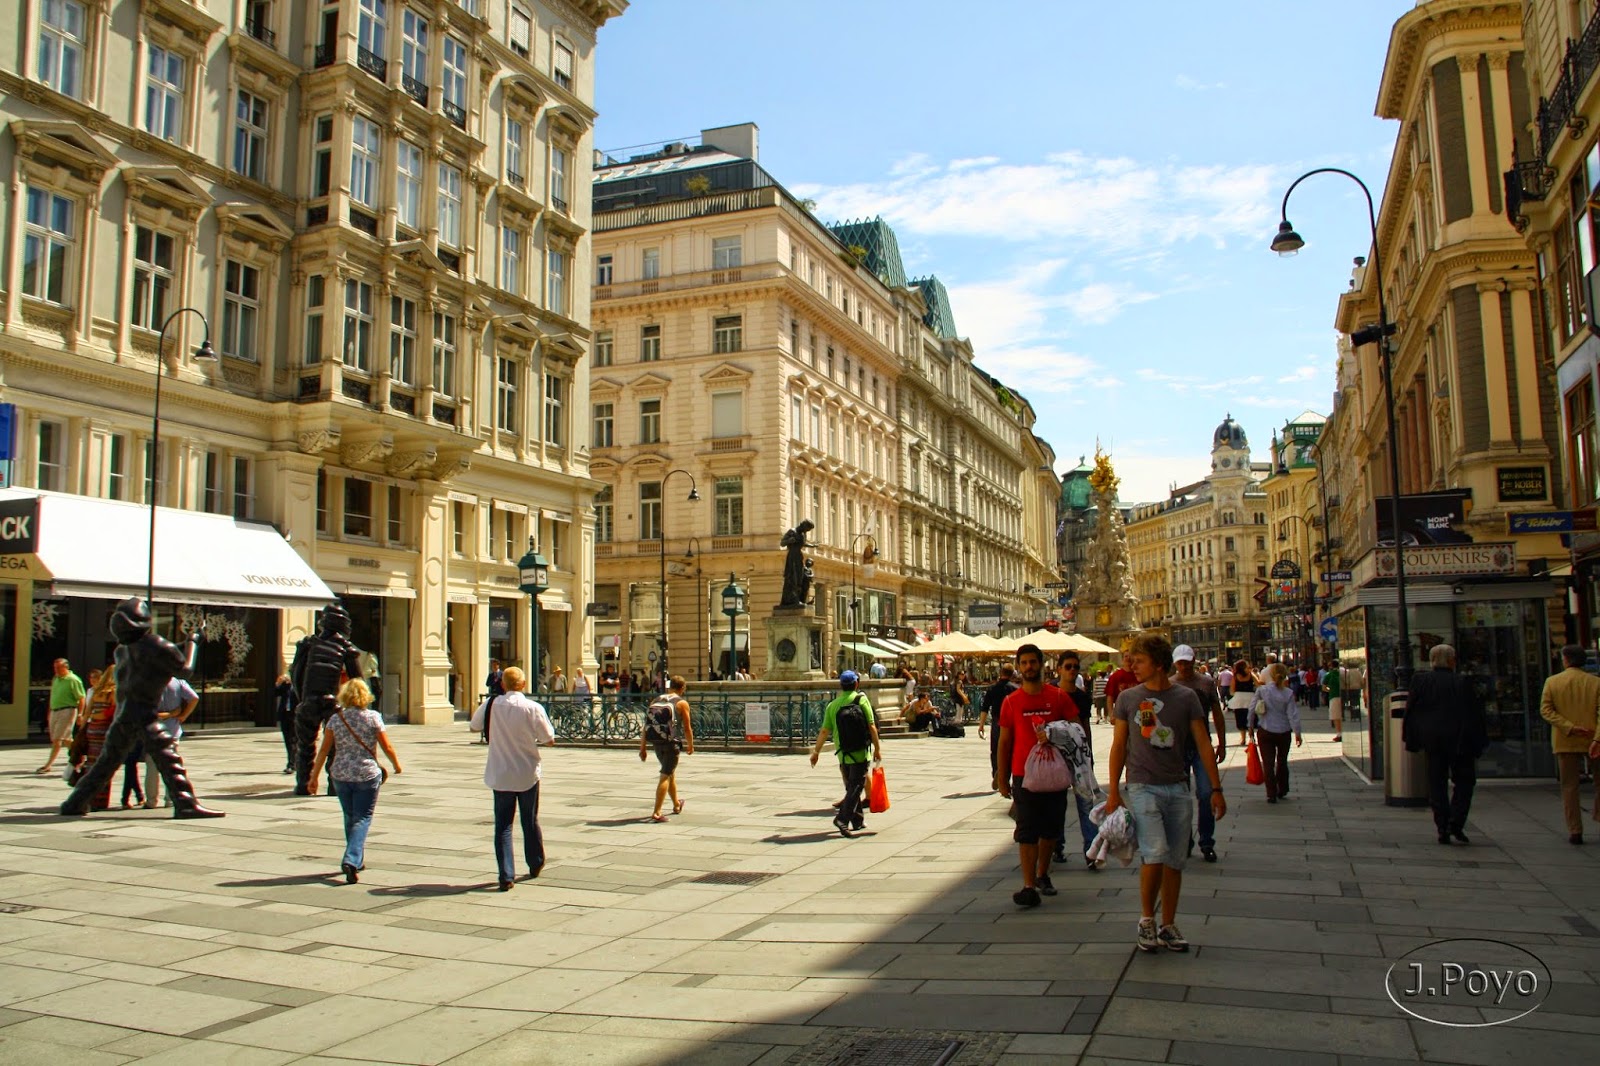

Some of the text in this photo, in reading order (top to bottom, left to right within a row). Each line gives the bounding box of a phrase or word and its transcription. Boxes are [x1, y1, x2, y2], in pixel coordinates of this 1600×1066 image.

[0, 516, 30, 541] CK
[1526, 517, 1566, 528] Tchibo
[241, 574, 312, 588] VON KÖCK
